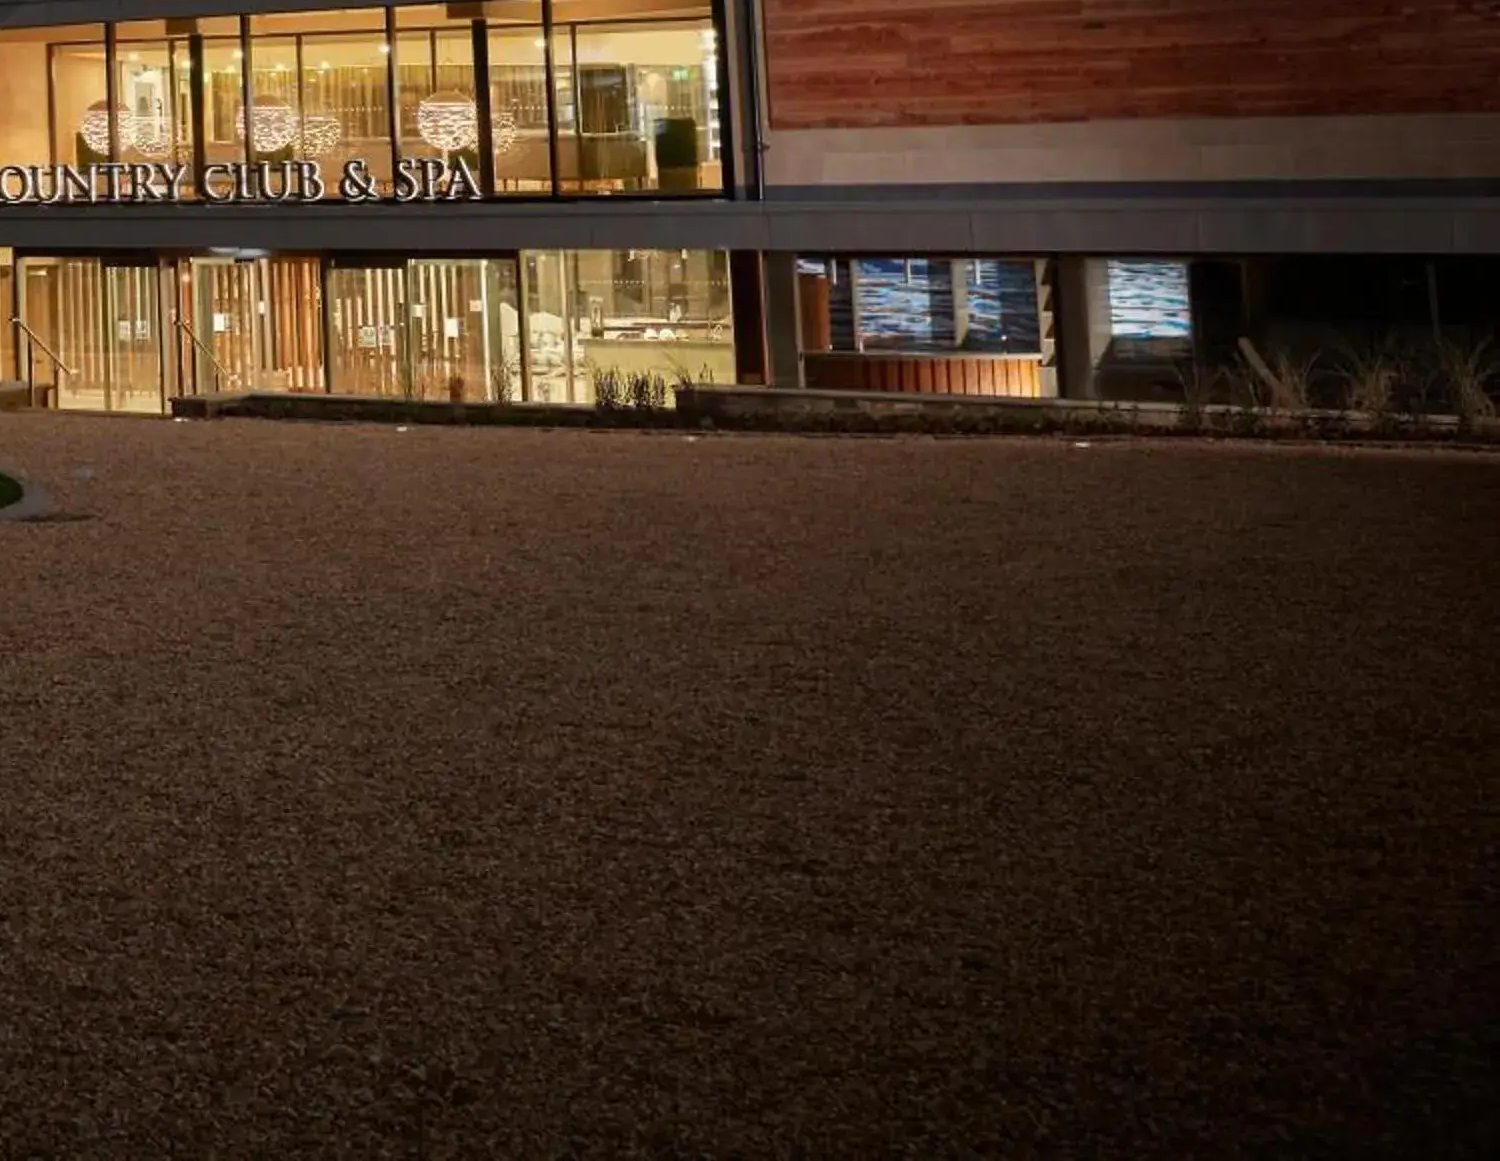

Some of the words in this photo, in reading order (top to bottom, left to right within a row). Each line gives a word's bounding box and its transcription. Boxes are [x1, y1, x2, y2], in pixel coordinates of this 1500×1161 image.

[202, 159, 325, 202] CLUB
[340, 158, 381, 201] &
[396, 155, 482, 201] SPA
